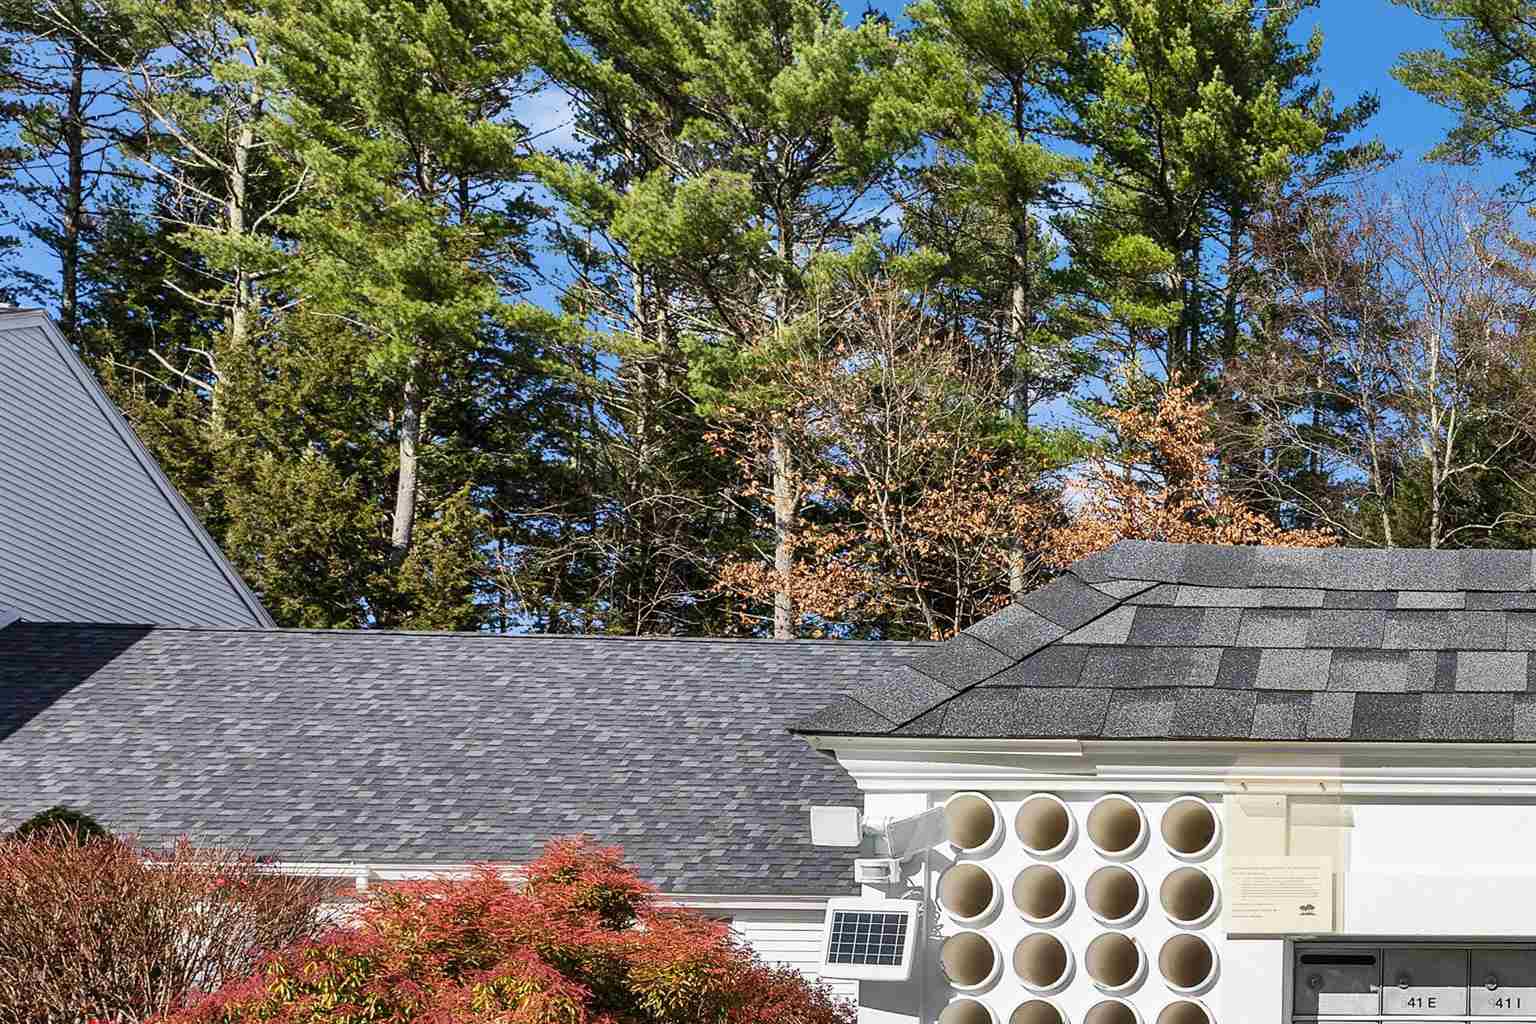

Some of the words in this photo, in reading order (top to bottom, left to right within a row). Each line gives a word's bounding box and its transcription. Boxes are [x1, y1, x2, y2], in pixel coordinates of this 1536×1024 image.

[1407, 996, 1423, 1009] 41
[1427, 996, 1437, 1009] E
[1495, 997, 1512, 1009] 41
